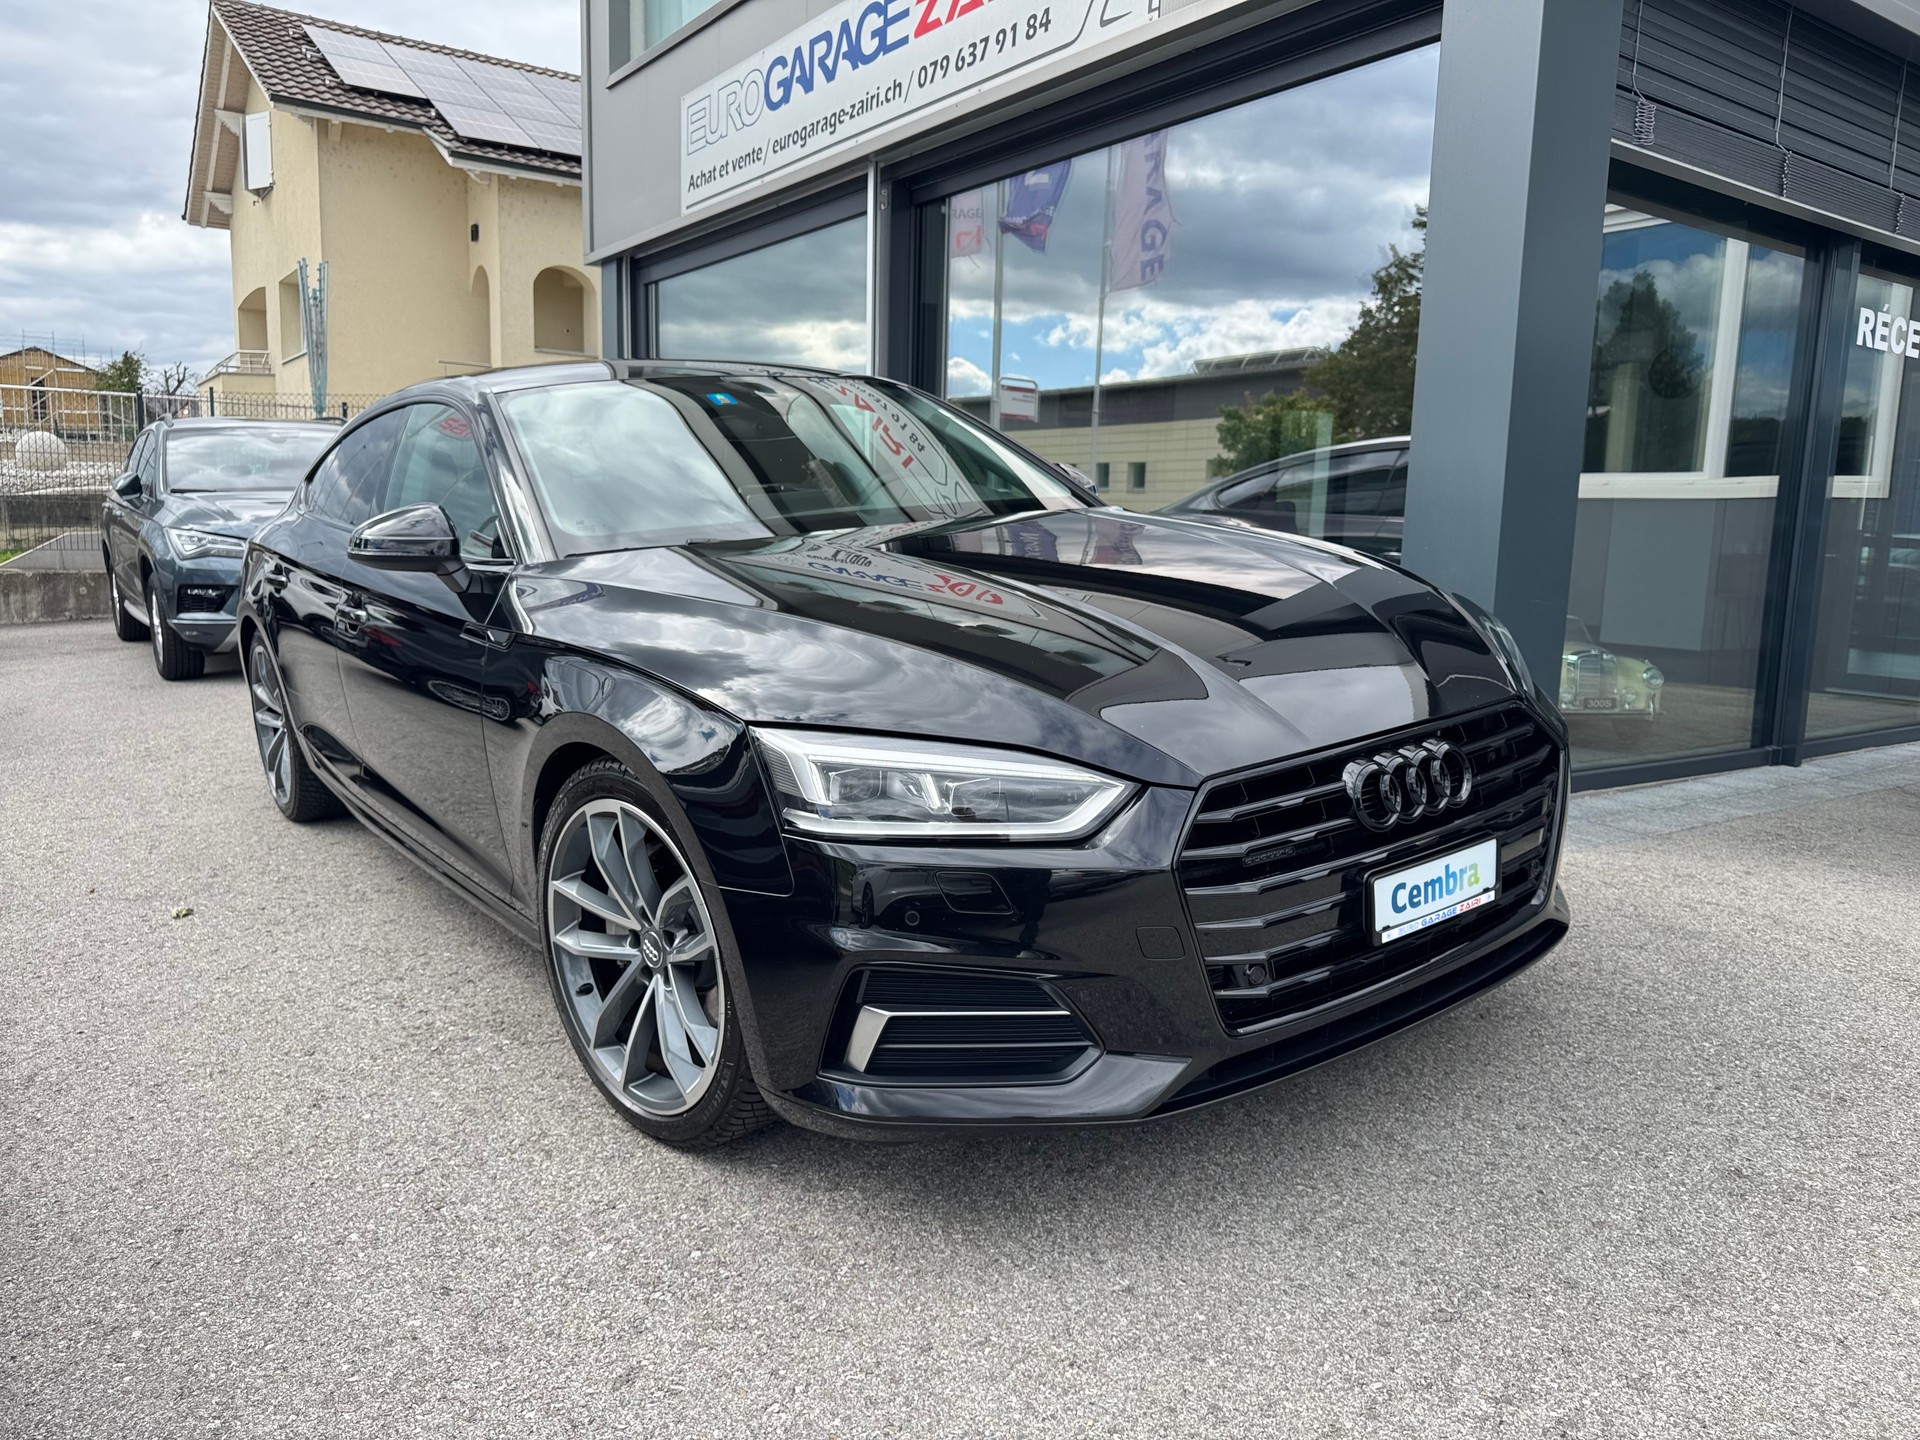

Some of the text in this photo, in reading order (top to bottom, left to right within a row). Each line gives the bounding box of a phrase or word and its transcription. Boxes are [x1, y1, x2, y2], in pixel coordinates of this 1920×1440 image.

[688, 165, 717, 193] Achat
[719, 159, 729, 178] et
[731, 146, 763, 172] vente
[772, 78, 902, 155] eurogarage-zairi.ch
[917, 54, 950, 89] 079
[954, 35, 990, 72] 637
[995, 21, 1018, 55] 91
[1025, 6, 1051, 41] 84
[1391, 863, 1480, 914] Cembra
[1421, 906, 1457, 927] GARAGE
[1459, 897, 1482, 912] ZAIRI
